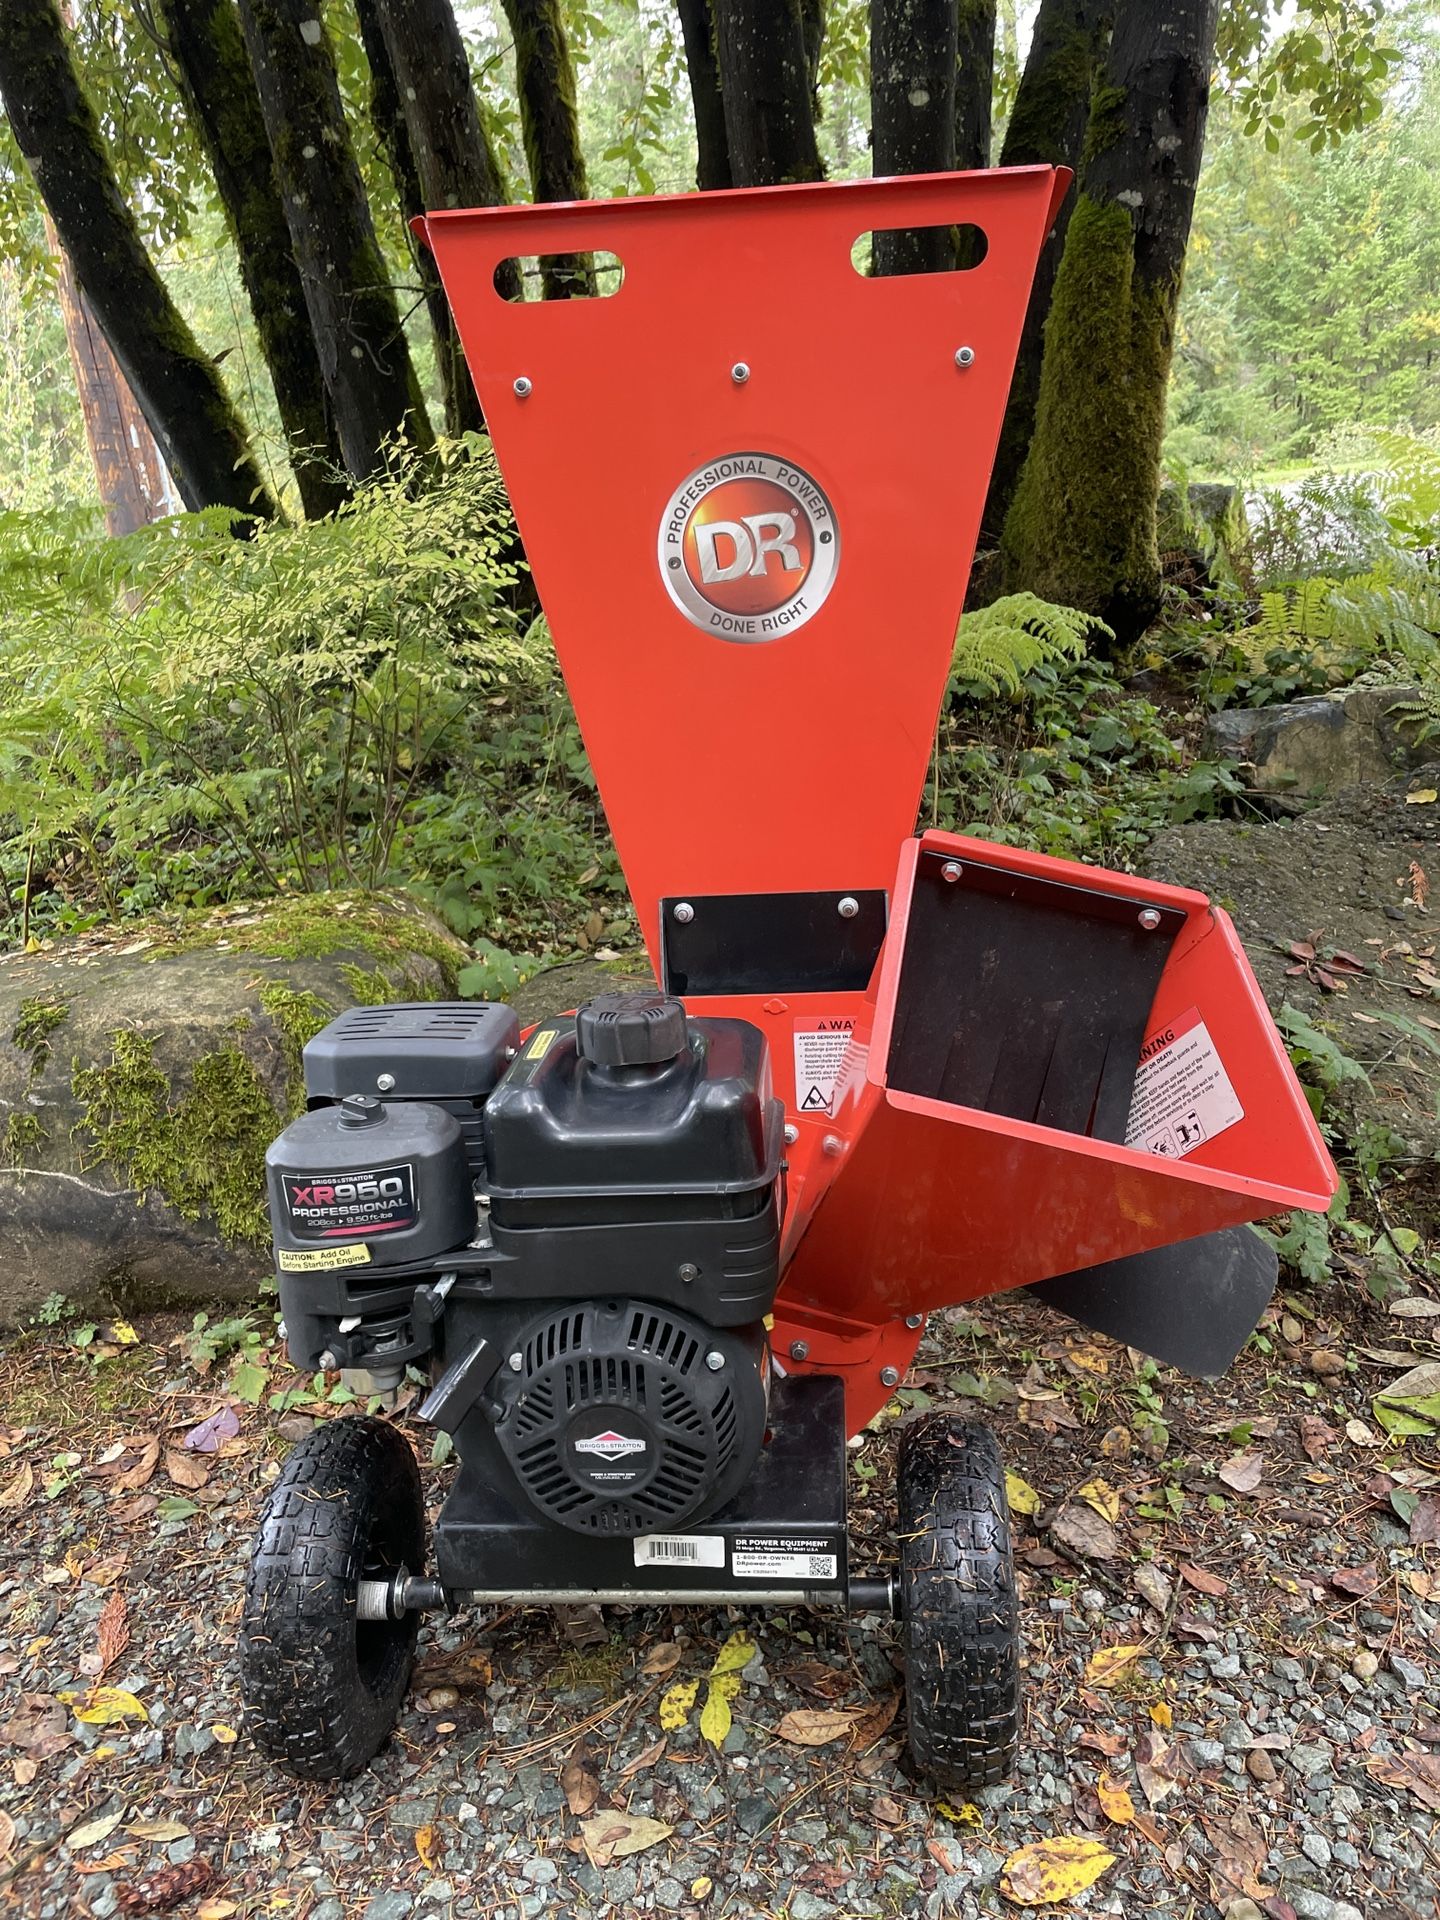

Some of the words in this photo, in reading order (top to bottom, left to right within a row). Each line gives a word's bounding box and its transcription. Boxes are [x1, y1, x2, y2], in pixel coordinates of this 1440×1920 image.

[667, 460, 767, 544] PROFESSIONAL
[776, 466, 827, 521] POWER
[694, 512, 804, 584] DR
[710, 612, 756, 633] DONE
[761, 597, 808, 632] RIGHT
[830, 1020, 856, 1029] WA
[292, 1177, 403, 1206] XR950
[292, 1198, 408, 1217] PROFESSIONAL
[346, 1215, 370, 1224] 9.50
[304, 1260, 334, 1268] Starting
[337, 1255, 365, 1264] Engine
[320, 1250, 336, 1259] Add
